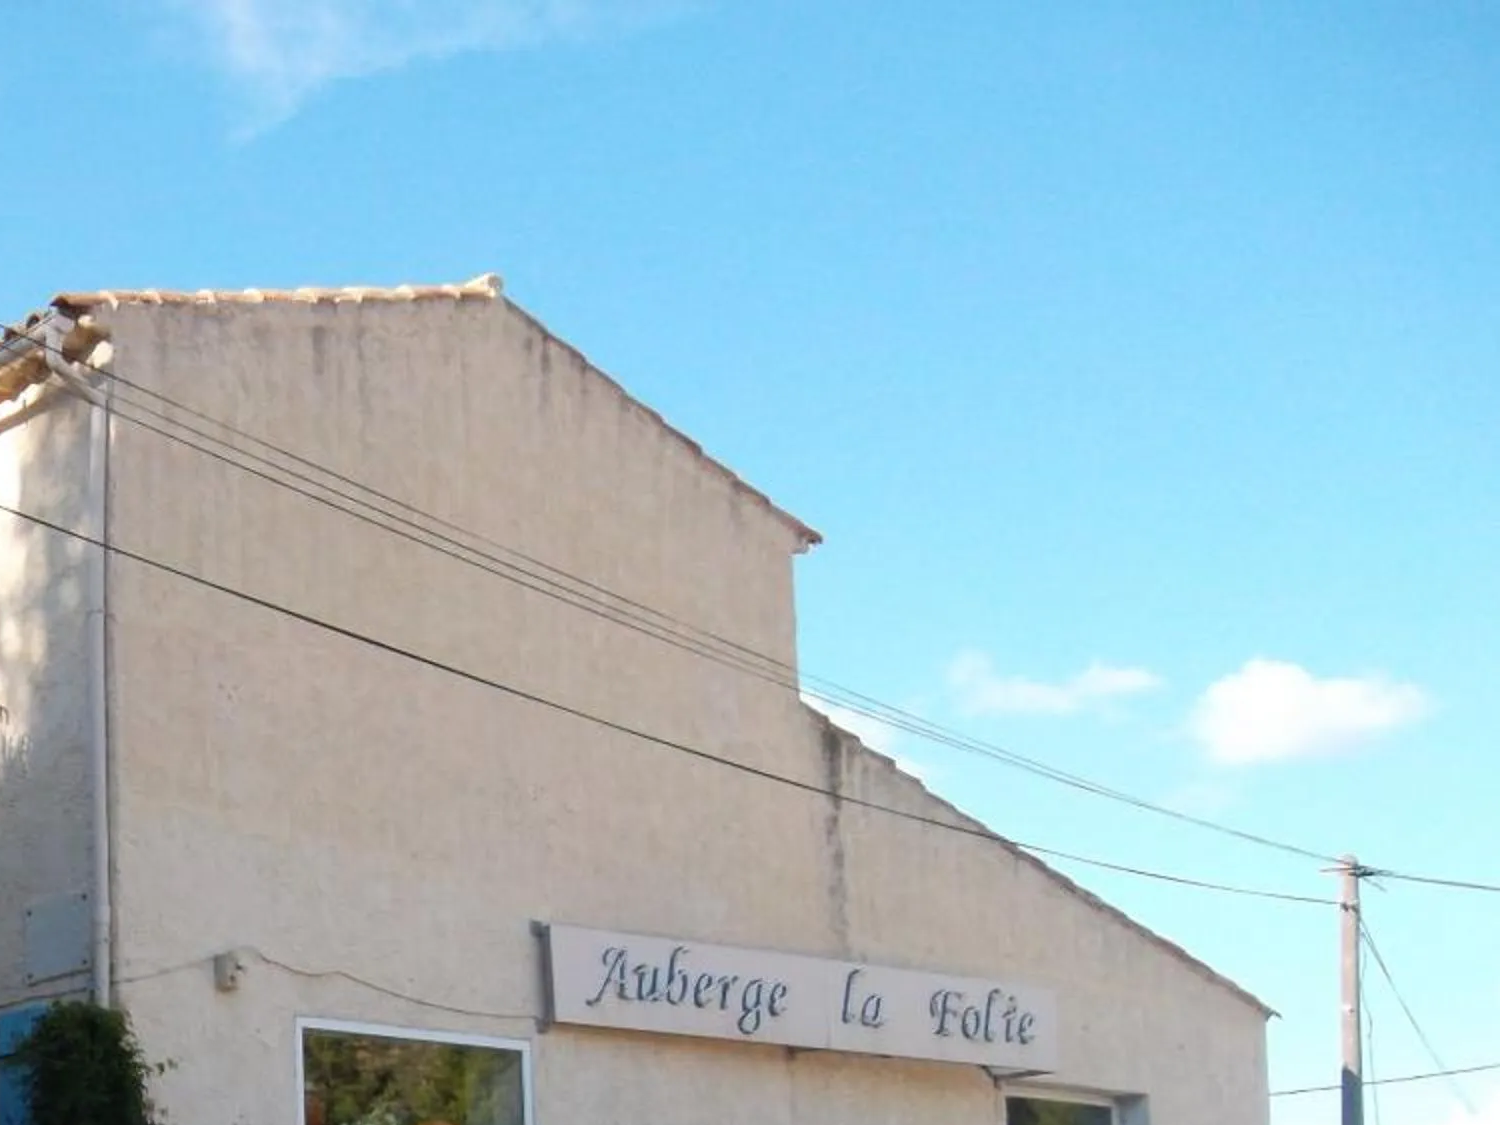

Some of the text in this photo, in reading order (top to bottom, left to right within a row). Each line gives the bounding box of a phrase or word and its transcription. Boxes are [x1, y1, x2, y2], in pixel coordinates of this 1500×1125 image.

[585, 945, 1036, 1045] Auberge la Folie
